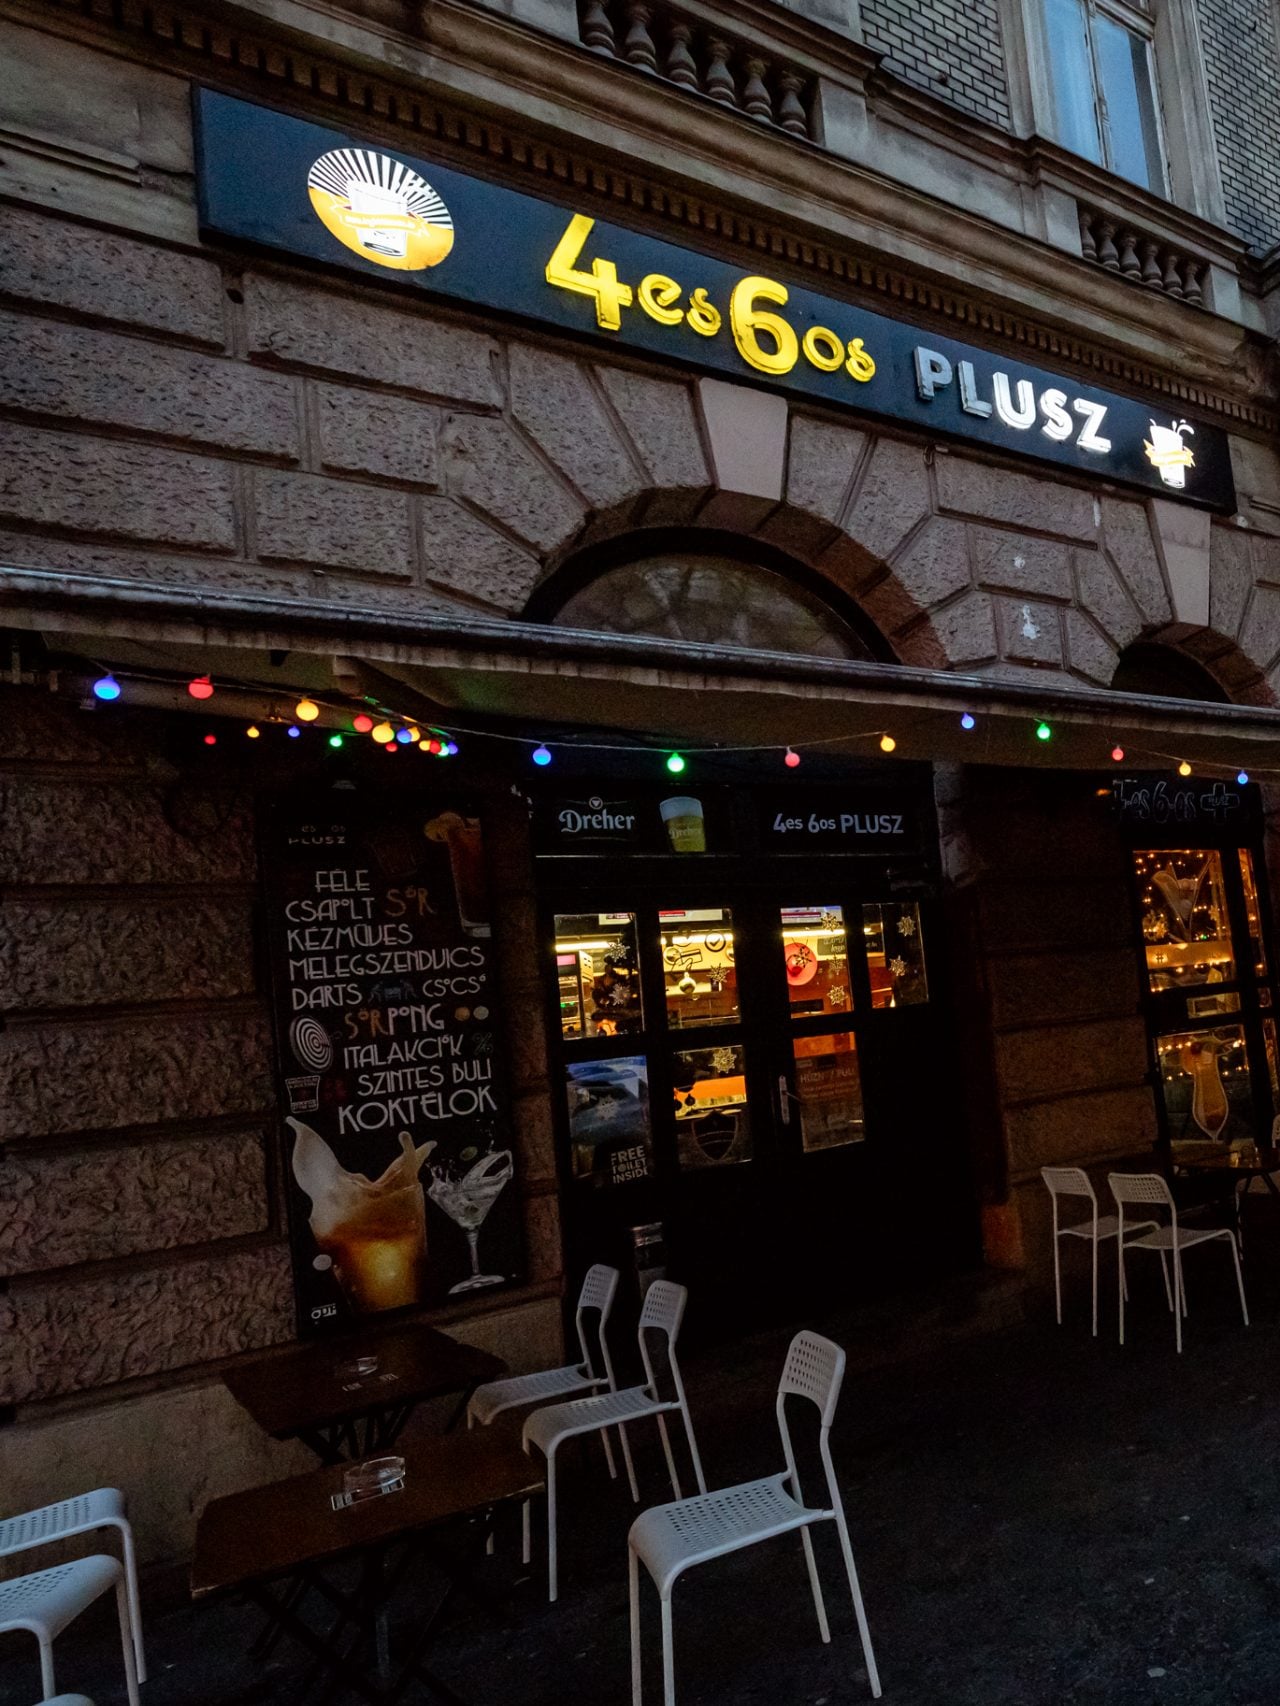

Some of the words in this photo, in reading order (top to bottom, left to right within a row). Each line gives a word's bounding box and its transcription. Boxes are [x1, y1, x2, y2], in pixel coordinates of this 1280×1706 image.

[914, 346, 1112, 453] PLUSZ
[558, 808, 636, 833] Dreher
[773, 812, 804, 833] 4es
[807, 813, 837, 833] 6os
[839, 814, 904, 834] PLUSZ
[285, 896, 375, 922] CSAPOLT
[288, 945, 485, 981] MELEGSZENDVICS
[291, 983, 363, 1011] DARTS
[343, 1032, 465, 1070] ITALAKCIÓK
[357, 1064, 446, 1097] SZINTES
[452, 1056, 493, 1084] BULI
[337, 1084, 498, 1135] KOKTÉLOK
[610, 1145, 646, 1165] FREE
[612, 1157, 648, 1175] TOILET
[612, 1166, 649, 1185] INSIDE
